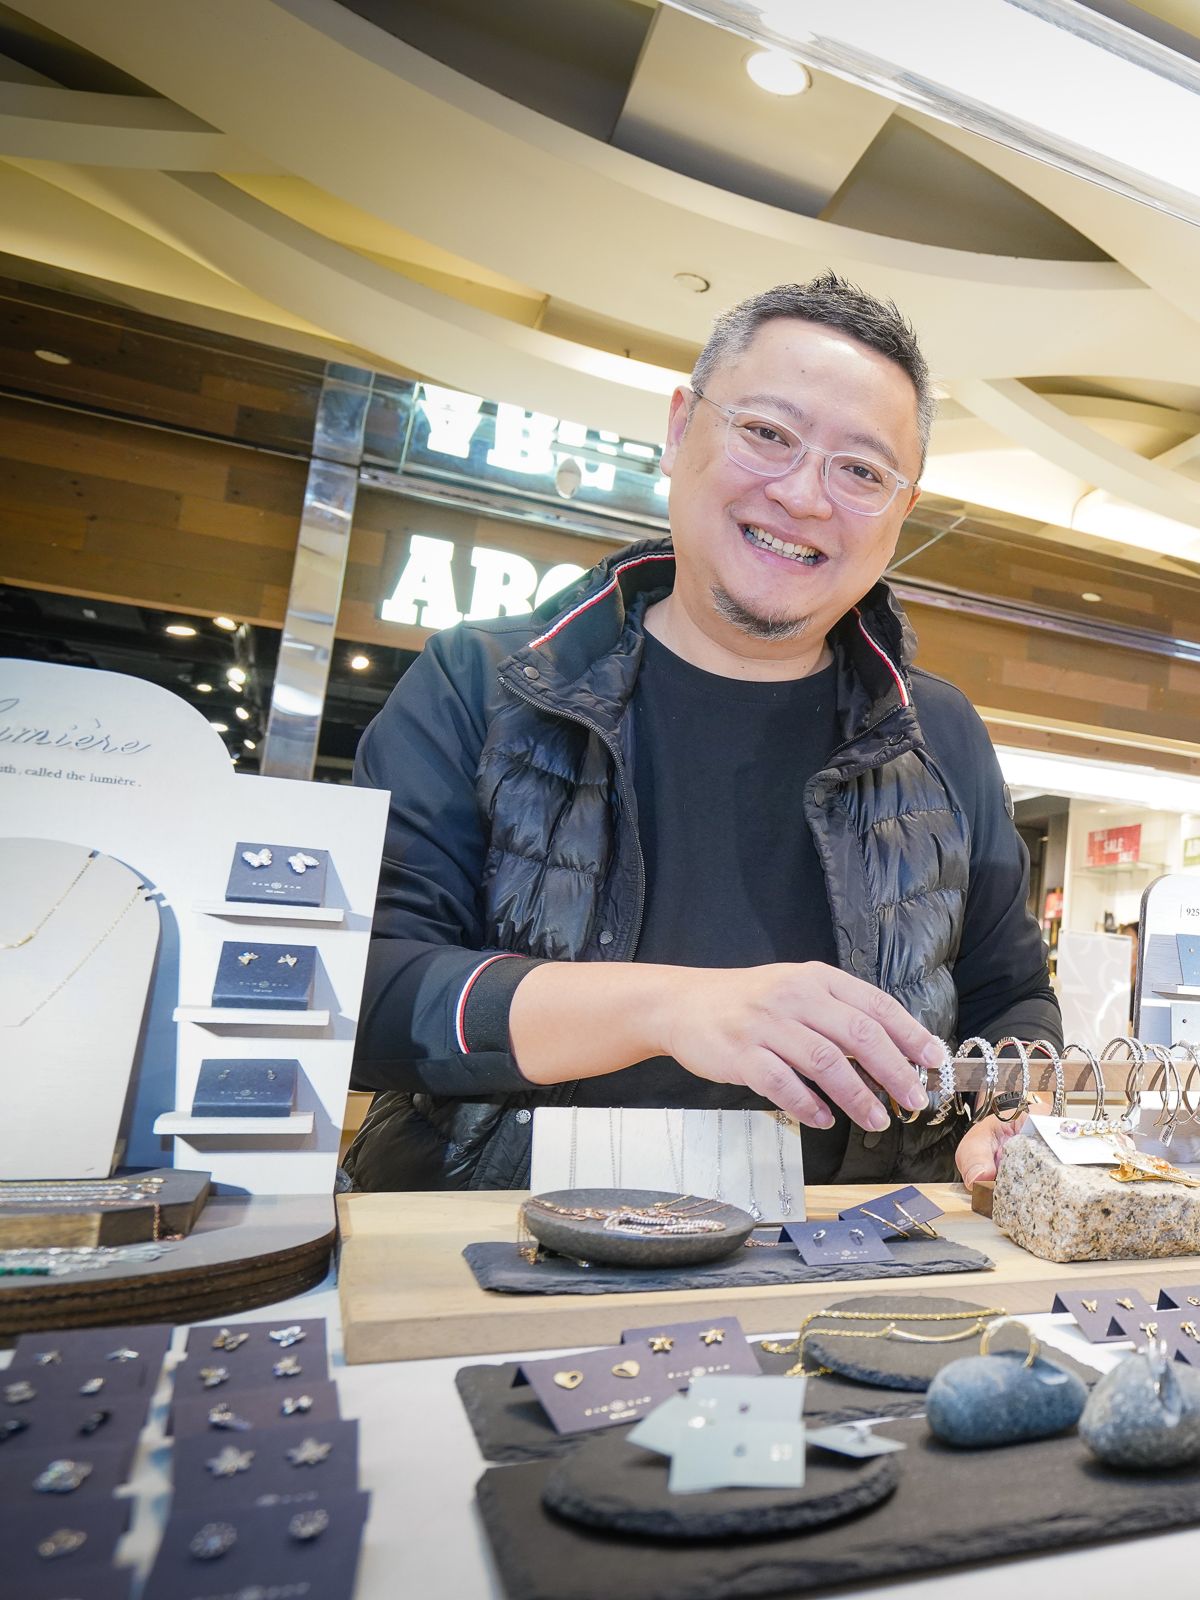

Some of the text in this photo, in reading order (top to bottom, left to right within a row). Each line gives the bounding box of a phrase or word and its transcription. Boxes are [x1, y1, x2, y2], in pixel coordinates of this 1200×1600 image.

[25, 768, 62, 779] called
[66, 771, 86, 782] the
[1103, 837, 1125, 854] SALE
[1186, 908, 1200, 917] 925
